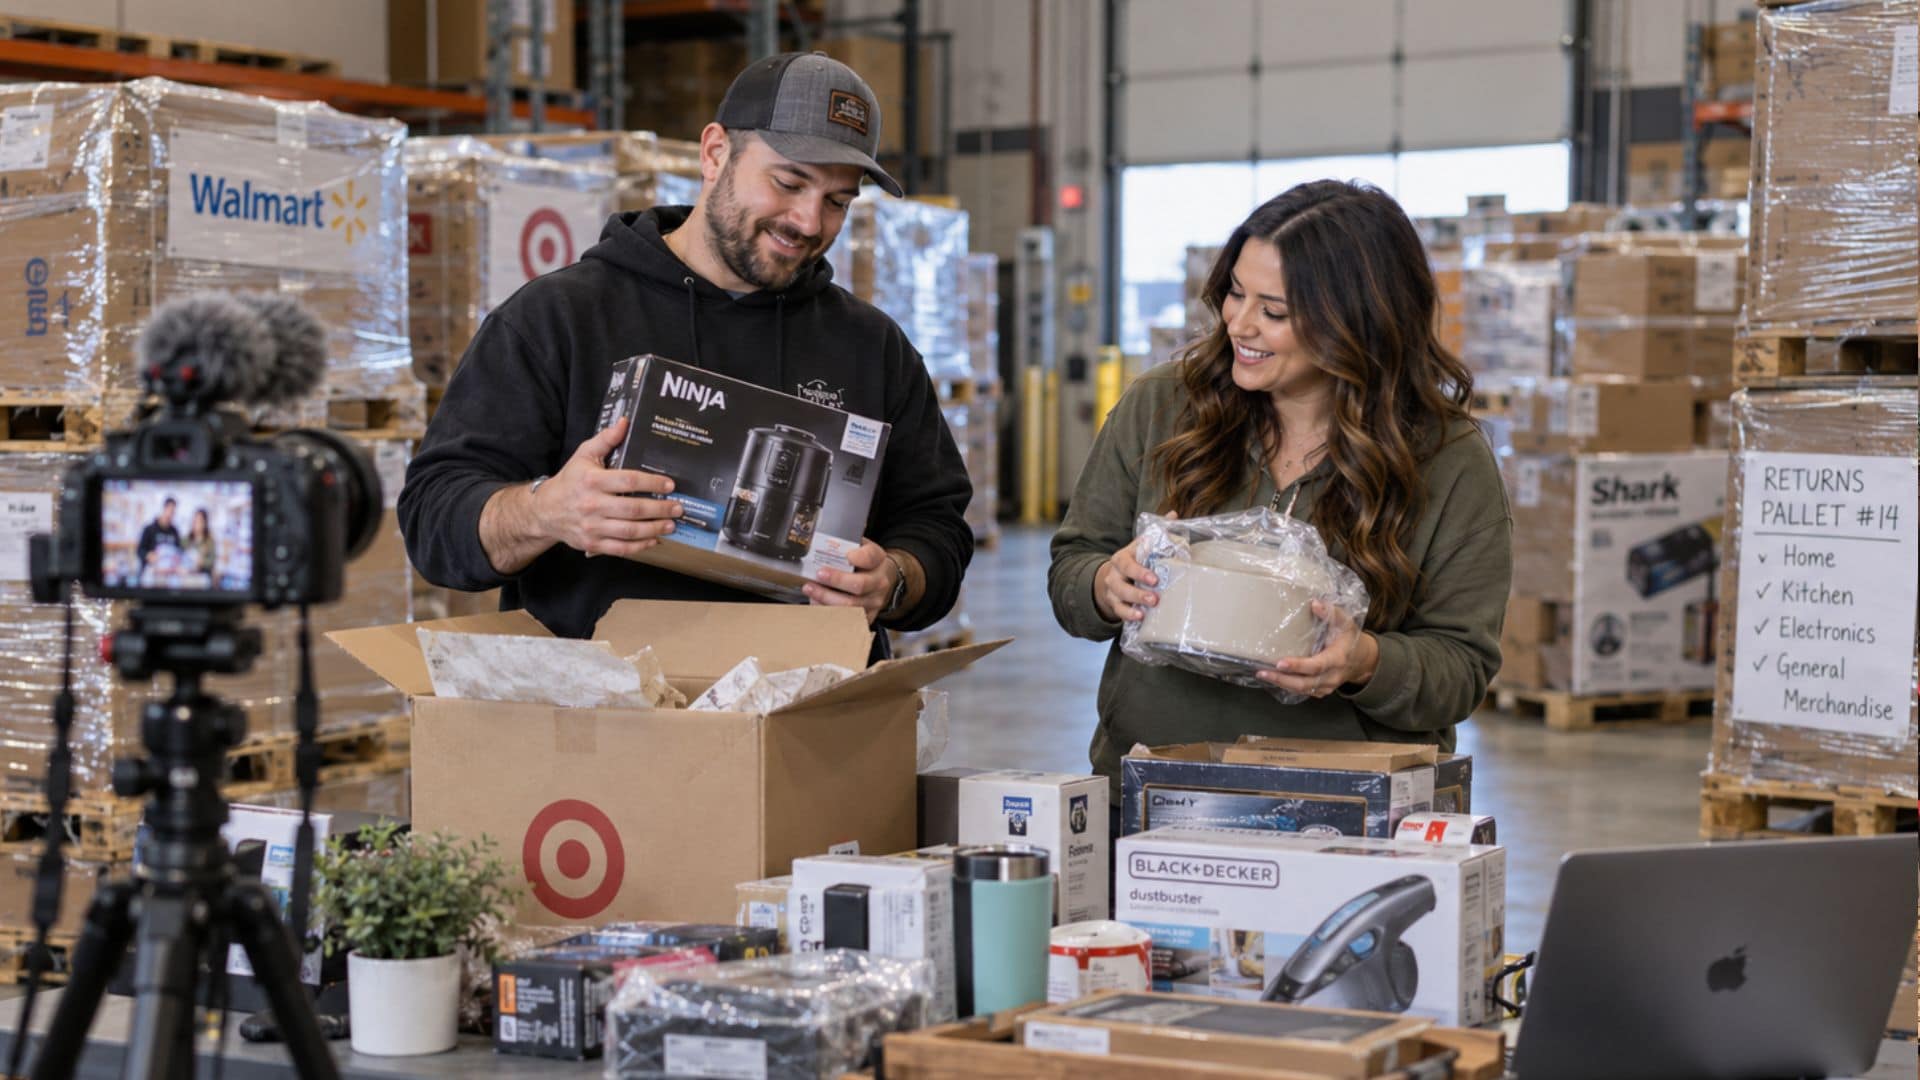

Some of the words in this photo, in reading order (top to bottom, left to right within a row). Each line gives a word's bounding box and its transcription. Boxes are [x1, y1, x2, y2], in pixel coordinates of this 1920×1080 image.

[190, 173, 325, 229] Walmart
[659, 370, 726, 412] NINJA
[1591, 472, 1681, 506] Shark
[1764, 466, 1865, 493] RETURNS
[1761, 500, 1846, 527] PALLET
[1856, 503, 1899, 531] #14
[1783, 543, 1836, 568] Home
[1781, 579, 1854, 606] Kitchen
[1779, 615, 1876, 644] Electronics
[1776, 651, 1845, 680] General
[1783, 687, 1894, 721] Merchandise
[1135, 858, 1273, 882] BLACK+DECKER
[1129, 888, 1203, 905] dustbuster
